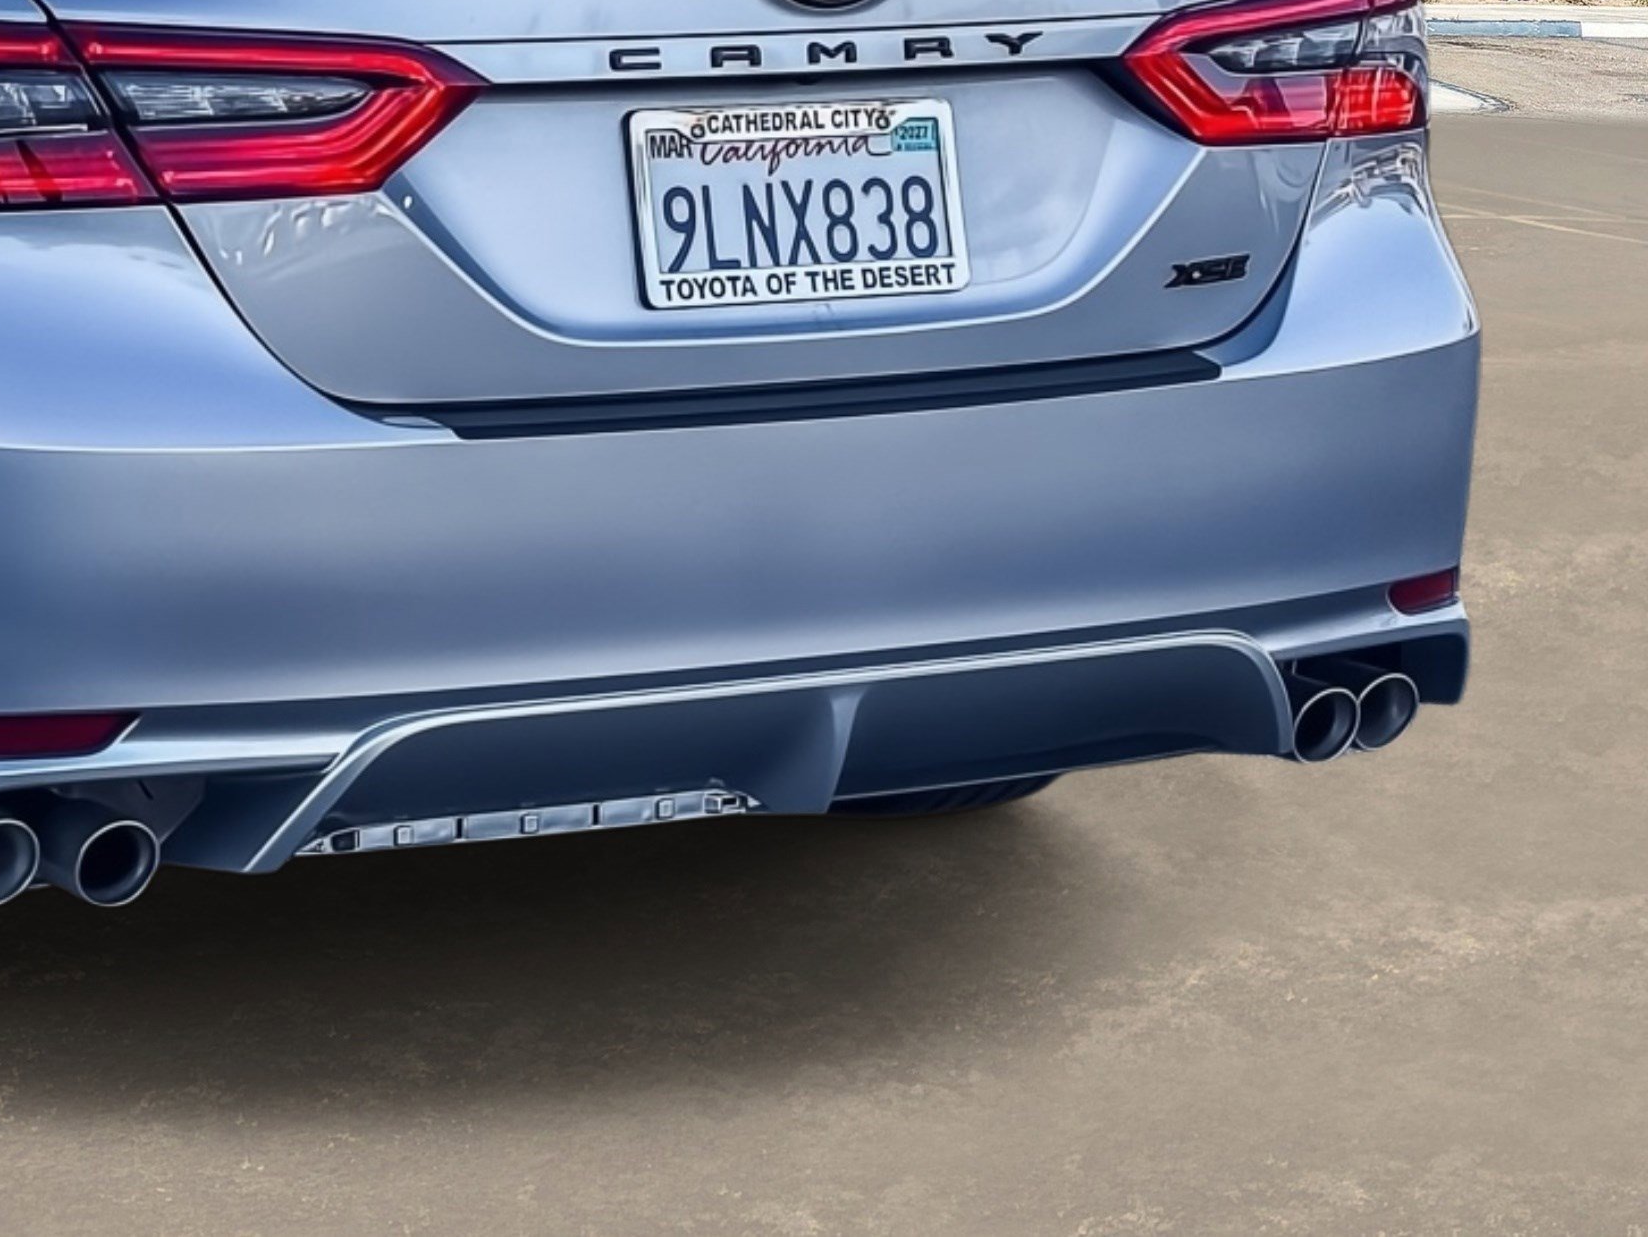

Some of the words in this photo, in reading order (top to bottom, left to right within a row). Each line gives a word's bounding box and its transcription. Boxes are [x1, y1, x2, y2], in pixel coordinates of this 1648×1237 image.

[609, 31, 1044, 71] CAMRY
[706, 109, 826, 134] CATHEDRAL
[831, 107, 876, 129] CITY
[650, 133, 693, 159] MAR
[700, 134, 893, 176] California
[662, 175, 939, 273] 9LNX838
[659, 275, 754, 302] TOYOTA
[765, 272, 798, 296] OF
[810, 268, 855, 293] THE
[862, 263, 956, 289] DESERT
